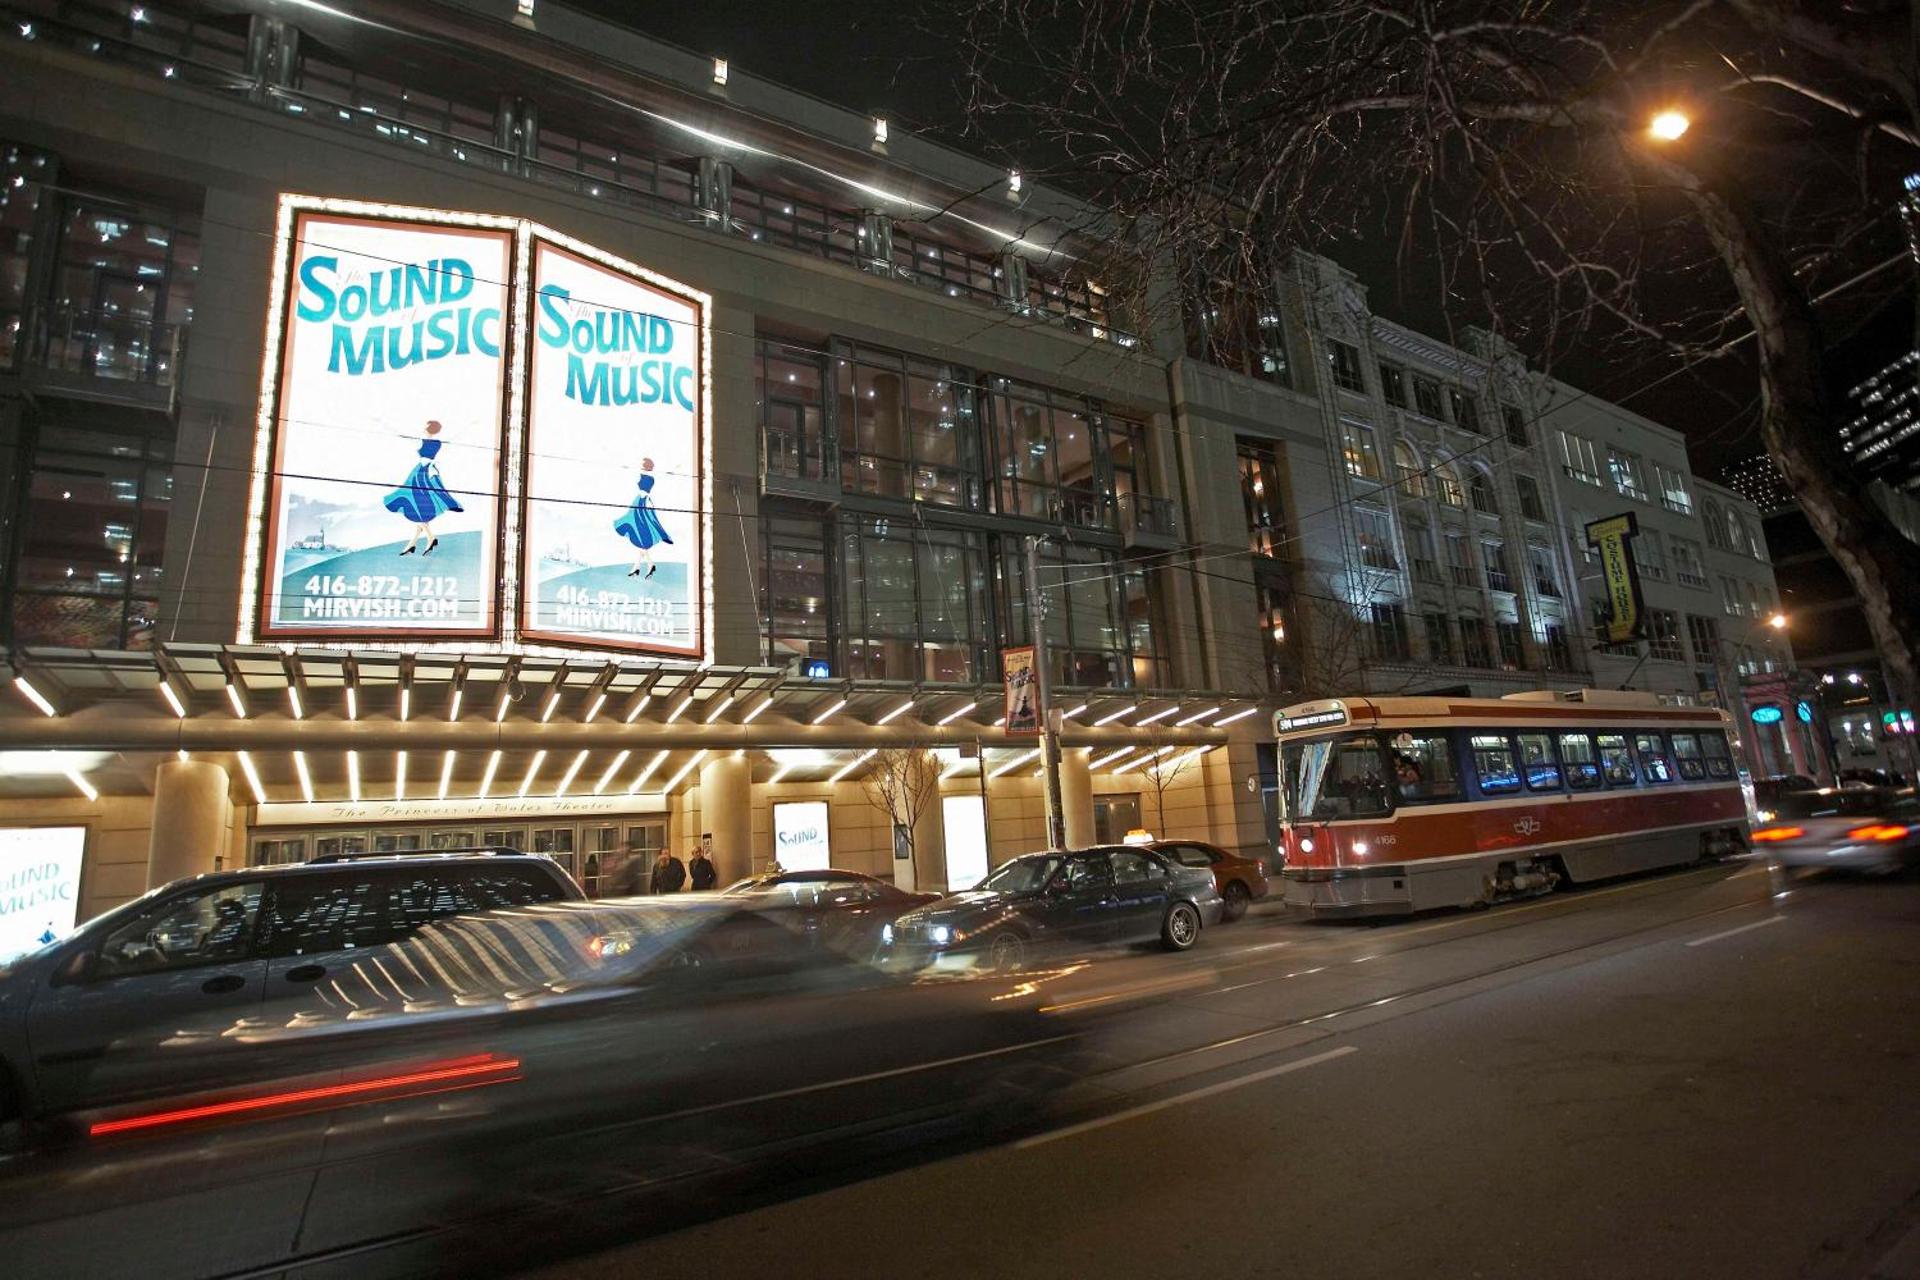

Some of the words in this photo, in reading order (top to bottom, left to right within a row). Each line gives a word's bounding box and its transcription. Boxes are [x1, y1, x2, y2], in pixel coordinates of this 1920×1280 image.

[304, 575, 458, 596] 416-872-1212
[303, 597, 459, 618] MIRVISH.COM
[557, 585, 673, 618] 416-872-1212
[556, 605, 674, 638] MIRVISH.COM
[331, 807, 366, 818] The
[382, 805, 457, 816] Princess
[467, 804, 483, 814] of
[494, 802, 541, 812] Wales
[552, 800, 613, 811] Theatre
